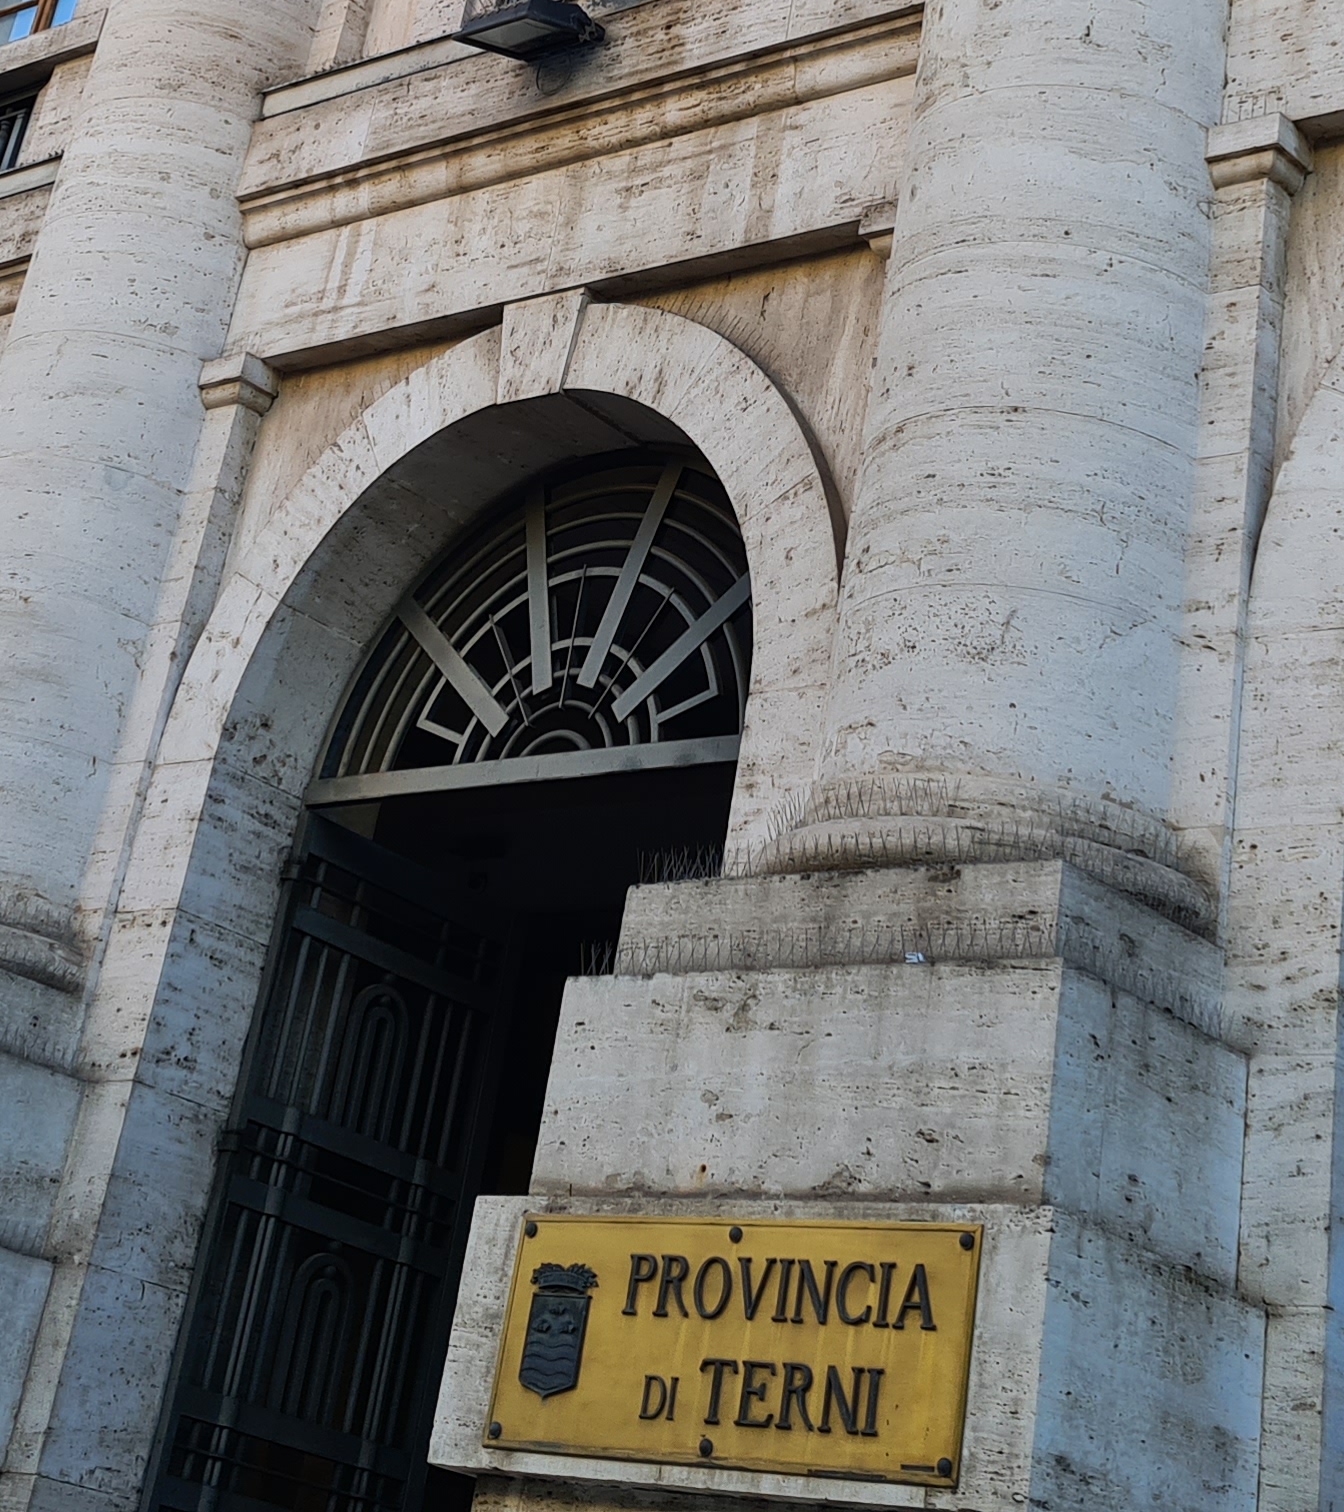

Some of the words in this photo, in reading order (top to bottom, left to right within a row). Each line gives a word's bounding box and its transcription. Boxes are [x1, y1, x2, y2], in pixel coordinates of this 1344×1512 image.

[621, 1253, 937, 1330] PROVINCIA
[638, 1374, 680, 1421] DI
[699, 1358, 886, 1437] TERNI
